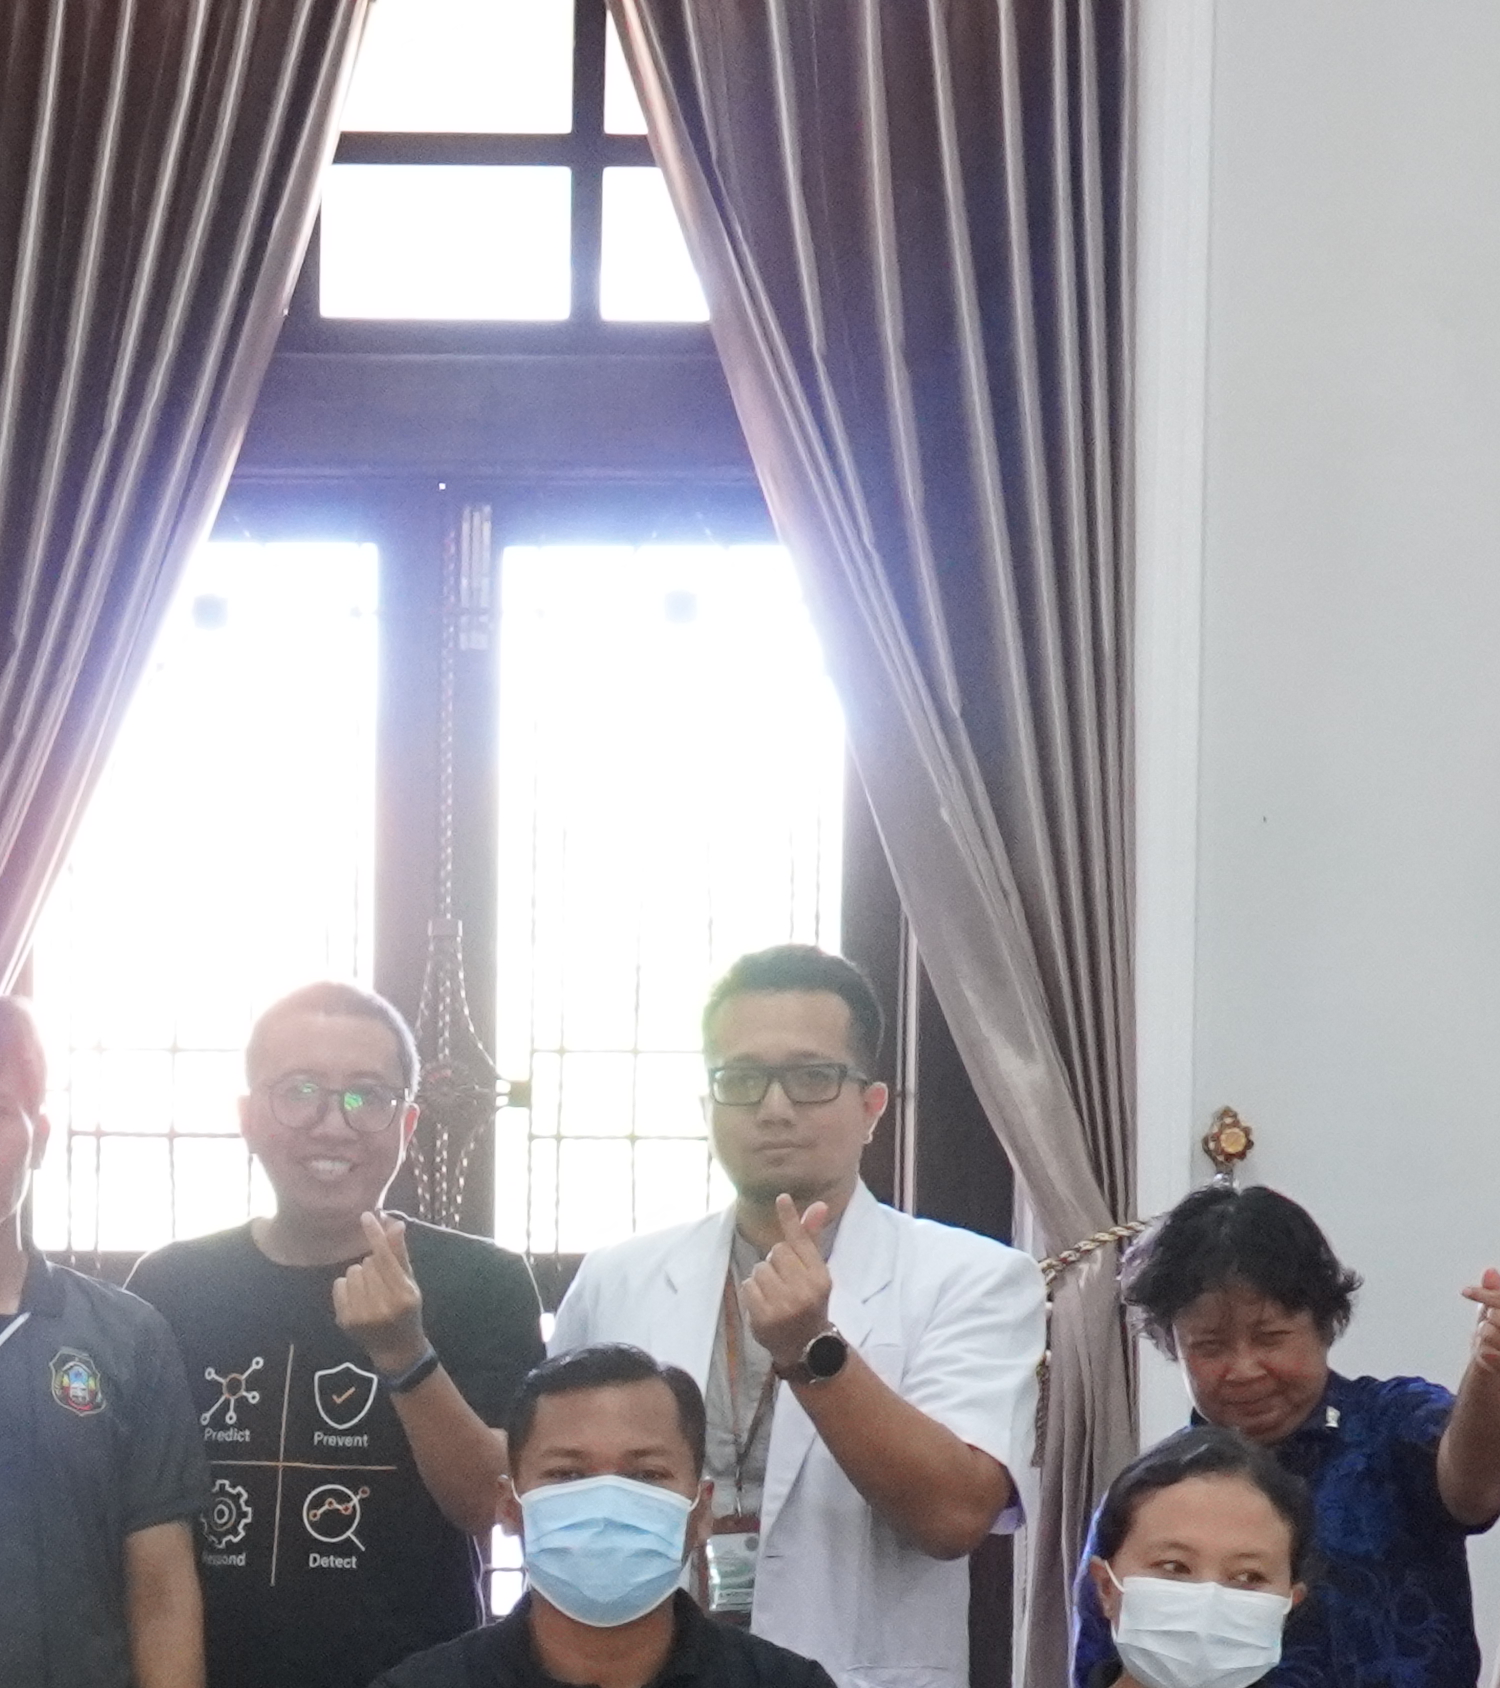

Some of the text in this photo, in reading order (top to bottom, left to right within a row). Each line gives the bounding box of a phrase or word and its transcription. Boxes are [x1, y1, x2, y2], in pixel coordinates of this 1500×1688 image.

[203, 1427, 251, 1442] Predict
[313, 1431, 369, 1448] Prevent
[308, 1552, 358, 1569] Detect
